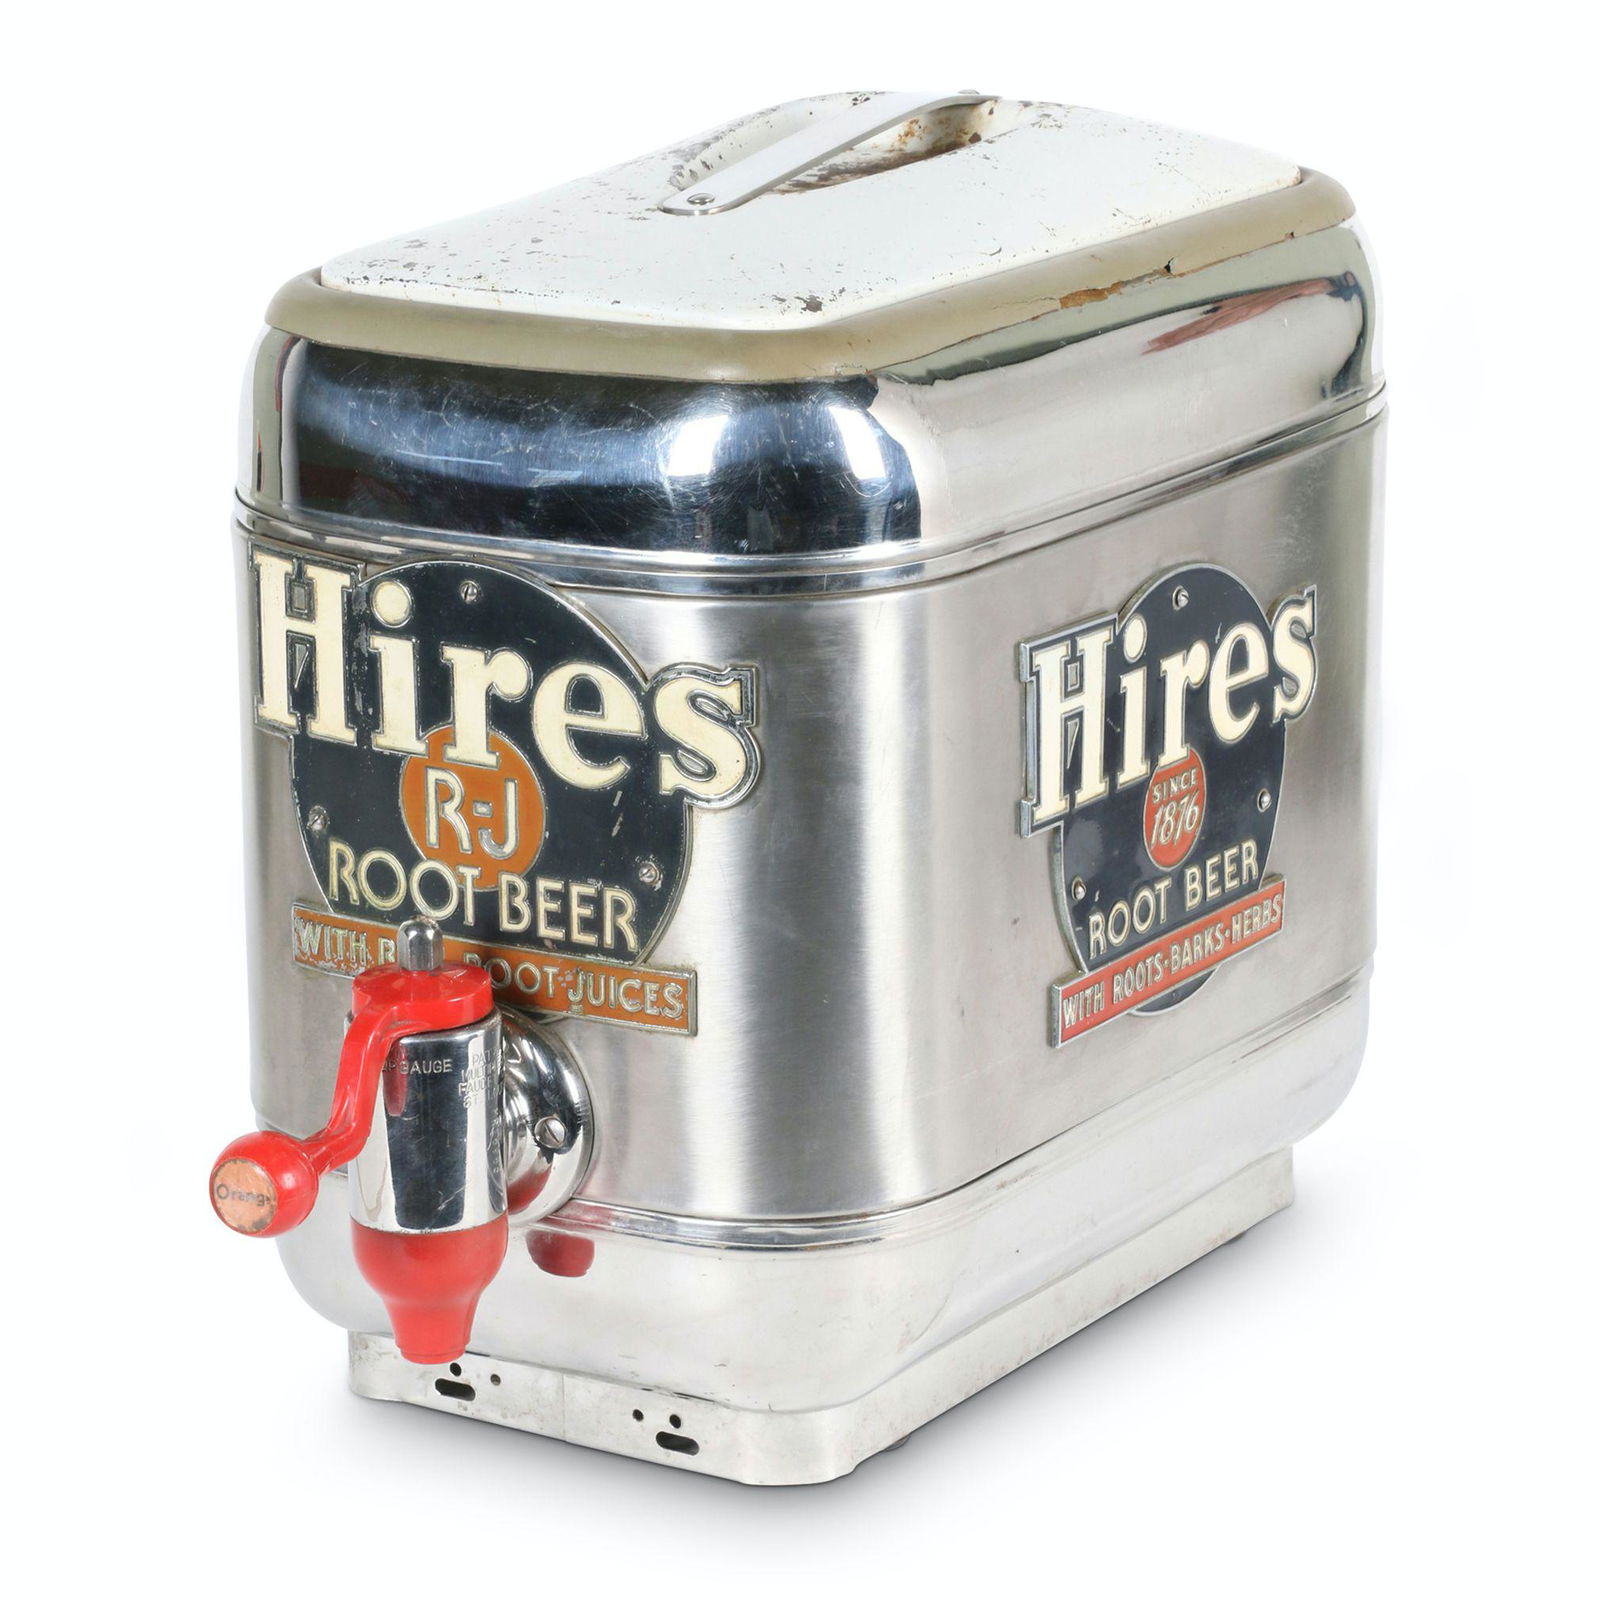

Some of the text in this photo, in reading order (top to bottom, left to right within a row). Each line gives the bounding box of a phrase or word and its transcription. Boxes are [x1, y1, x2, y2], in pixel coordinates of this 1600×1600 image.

[254, 554, 752, 798] Hires
[1033, 594, 1314, 822] Hires
[424, 766, 520, 860] R-J
[1150, 790, 1200, 849] 1876
[1152, 768, 1198, 804] SINCE
[329, 838, 639, 951] ROOT BEER
[1089, 838, 1259, 960] ROOT BEER
[295, 916, 367, 968] WITH
[567, 966, 684, 1020] JUICES
[1063, 981, 1105, 1029] WITH
